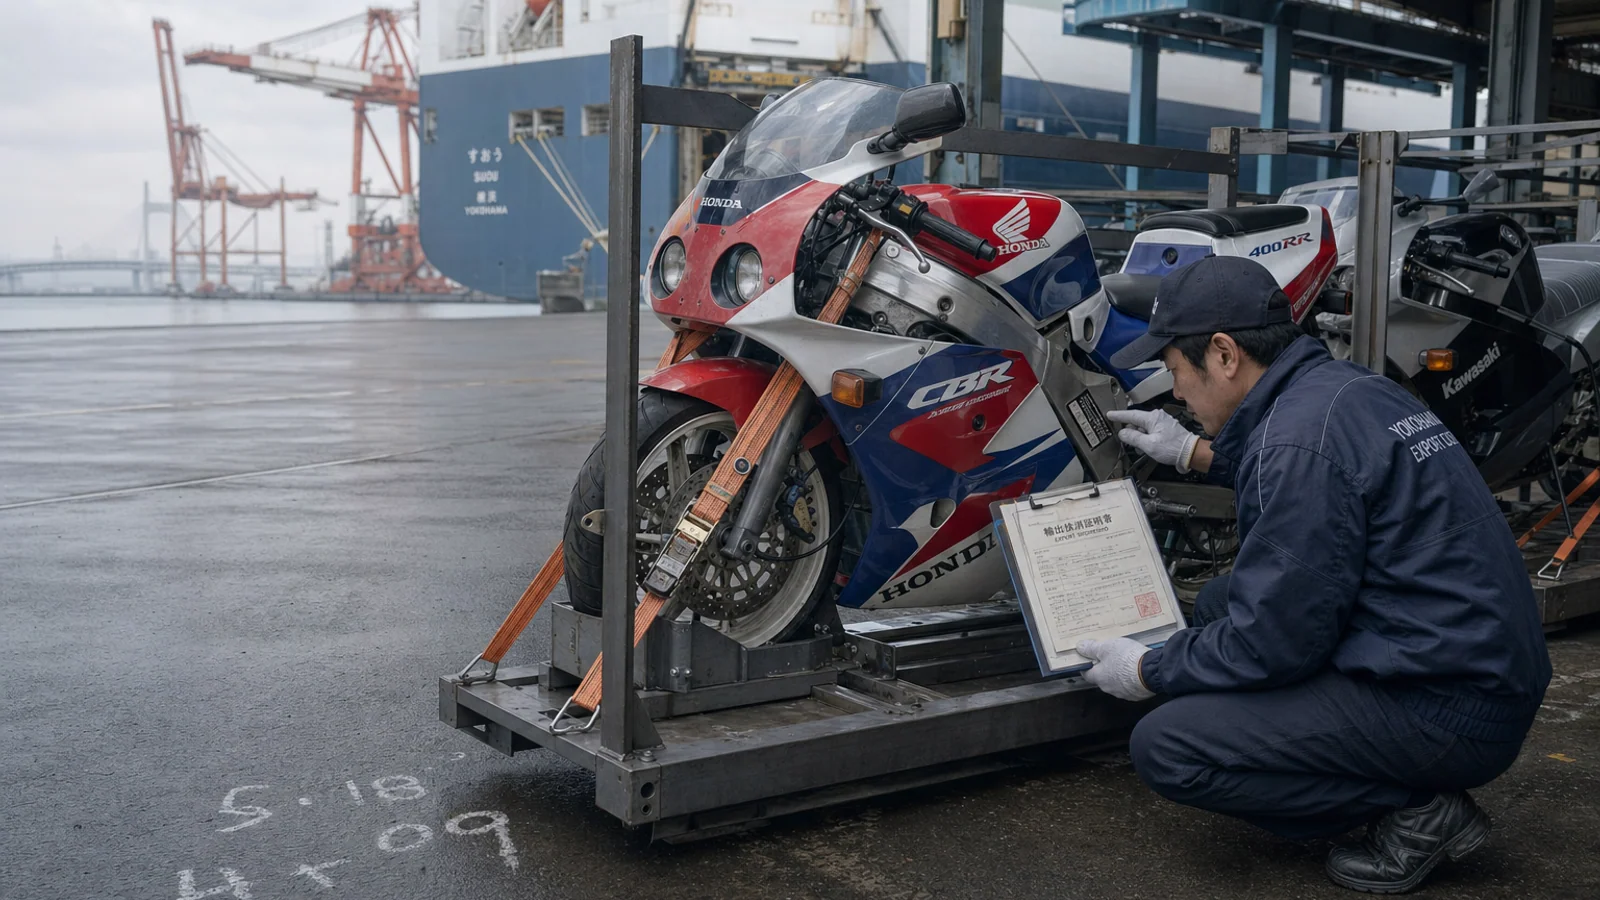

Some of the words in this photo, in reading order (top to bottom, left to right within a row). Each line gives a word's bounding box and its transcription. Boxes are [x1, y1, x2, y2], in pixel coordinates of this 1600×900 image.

[700, 196, 743, 209] HONDA
[997, 237, 1051, 256] HONDA
[1248, 232, 1314, 257] 400RR
[1441, 341, 1501, 399] Kawasaki
[907, 359, 1015, 410] CBR
